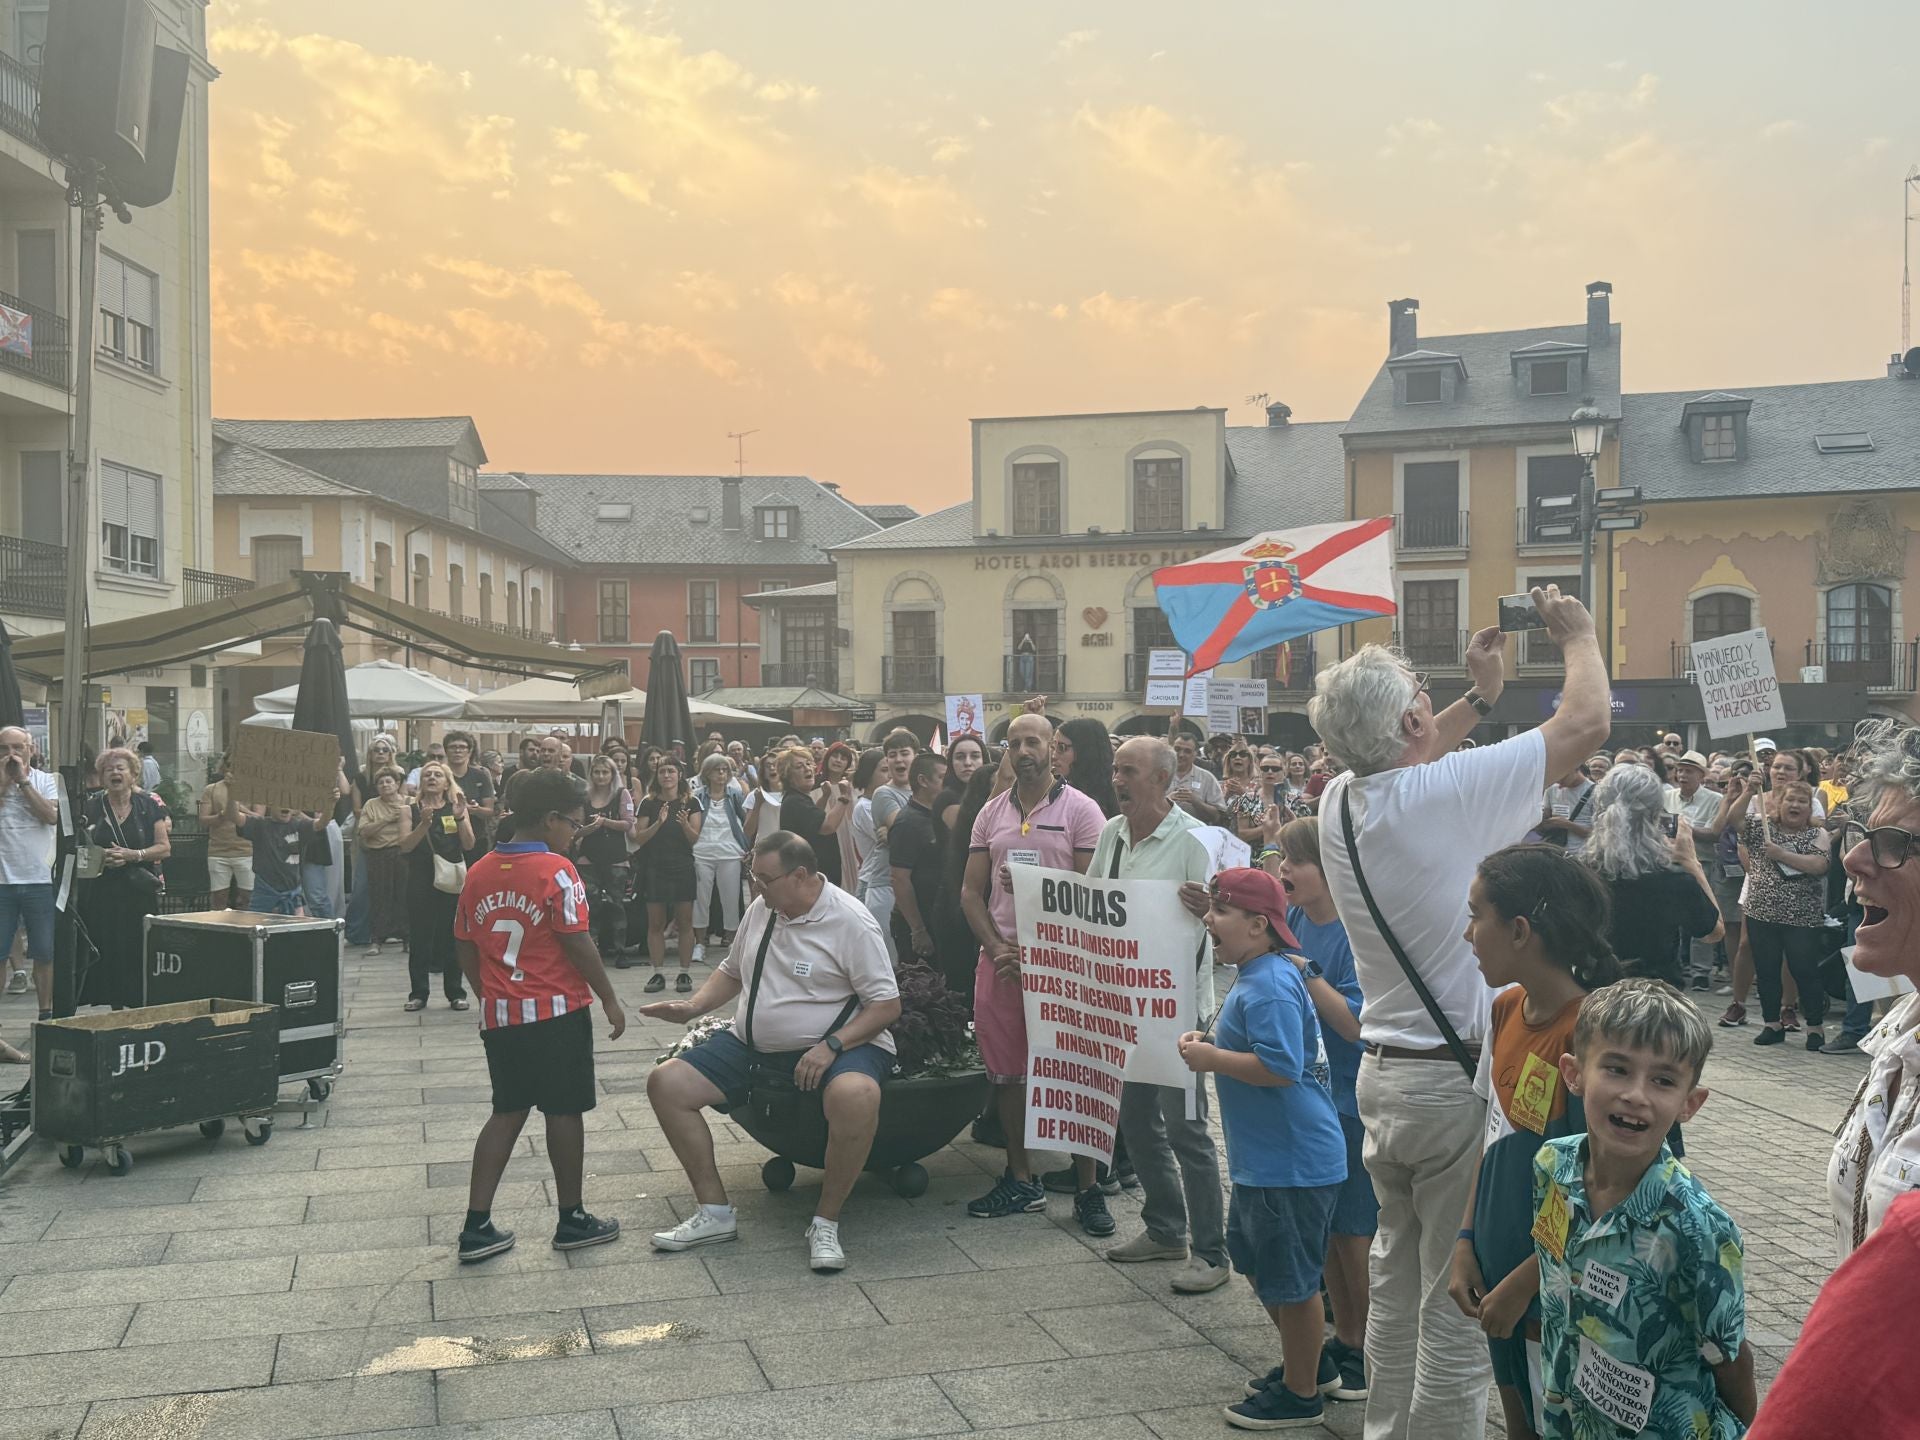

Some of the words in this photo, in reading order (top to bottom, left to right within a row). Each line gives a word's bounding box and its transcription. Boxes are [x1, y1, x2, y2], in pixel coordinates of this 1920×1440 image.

[975, 555, 1030, 570] HOTEL
[1089, 552, 1151, 567] BIERZO
[1697, 645, 1743, 670] MAÑUECO
[1744, 643, 1753, 660] Y
[1703, 660, 1760, 686] QUIÑONES
[1076, 702, 1114, 711] VISION
[1714, 695, 1772, 721] MAZONES
[474, 890, 545, 927] GRIEZMANN
[1042, 878, 1127, 927] BOUZAS
[491, 919, 525, 981] 7
[1036, 922, 1064, 944] PIDE
[1066, 926, 1080, 948] LA
[1080, 930, 1139, 960] DIMISION
[153, 951, 182, 976] JLD
[1030, 946, 1085, 977] MAÑUECO
[1086, 960, 1092, 980] Y
[1094, 963, 1177, 990] QUIÑONES.
[1022, 972, 1063, 996] OUZAS
[1065, 980, 1078, 1000] SE
[1080, 984, 1133, 1016] INCENDIA
[1136, 997, 1147, 1018] Y
[1151, 998, 1177, 1019] NO
[1040, 1002, 1082, 1028] RECIBE
[1084, 1012, 1122, 1040] AYUDA
[1123, 1022, 1138, 1045] DE
[111, 1040, 166, 1077] JLD
[1056, 1031, 1102, 1060] NINGUN
[1103, 1043, 1127, 1069] TIPO
[1031, 1086, 1042, 1107] A
[1045, 1087, 1073, 1111] DOS
[1037, 1117, 1056, 1139] DE
[1586, 1271, 1620, 1293] NUNCA
[1591, 1262, 1620, 1282] Lumes
[1588, 1283, 1614, 1300] MAIS
[1590, 1346, 1641, 1385] MAÑUECOS
[1643, 1379, 1650, 1389] Y
[1592, 1361, 1641, 1398] QUIÑONES
[1579, 1374, 1644, 1430] MAZONES
[1597, 1380, 1648, 1415] NUESTROS
